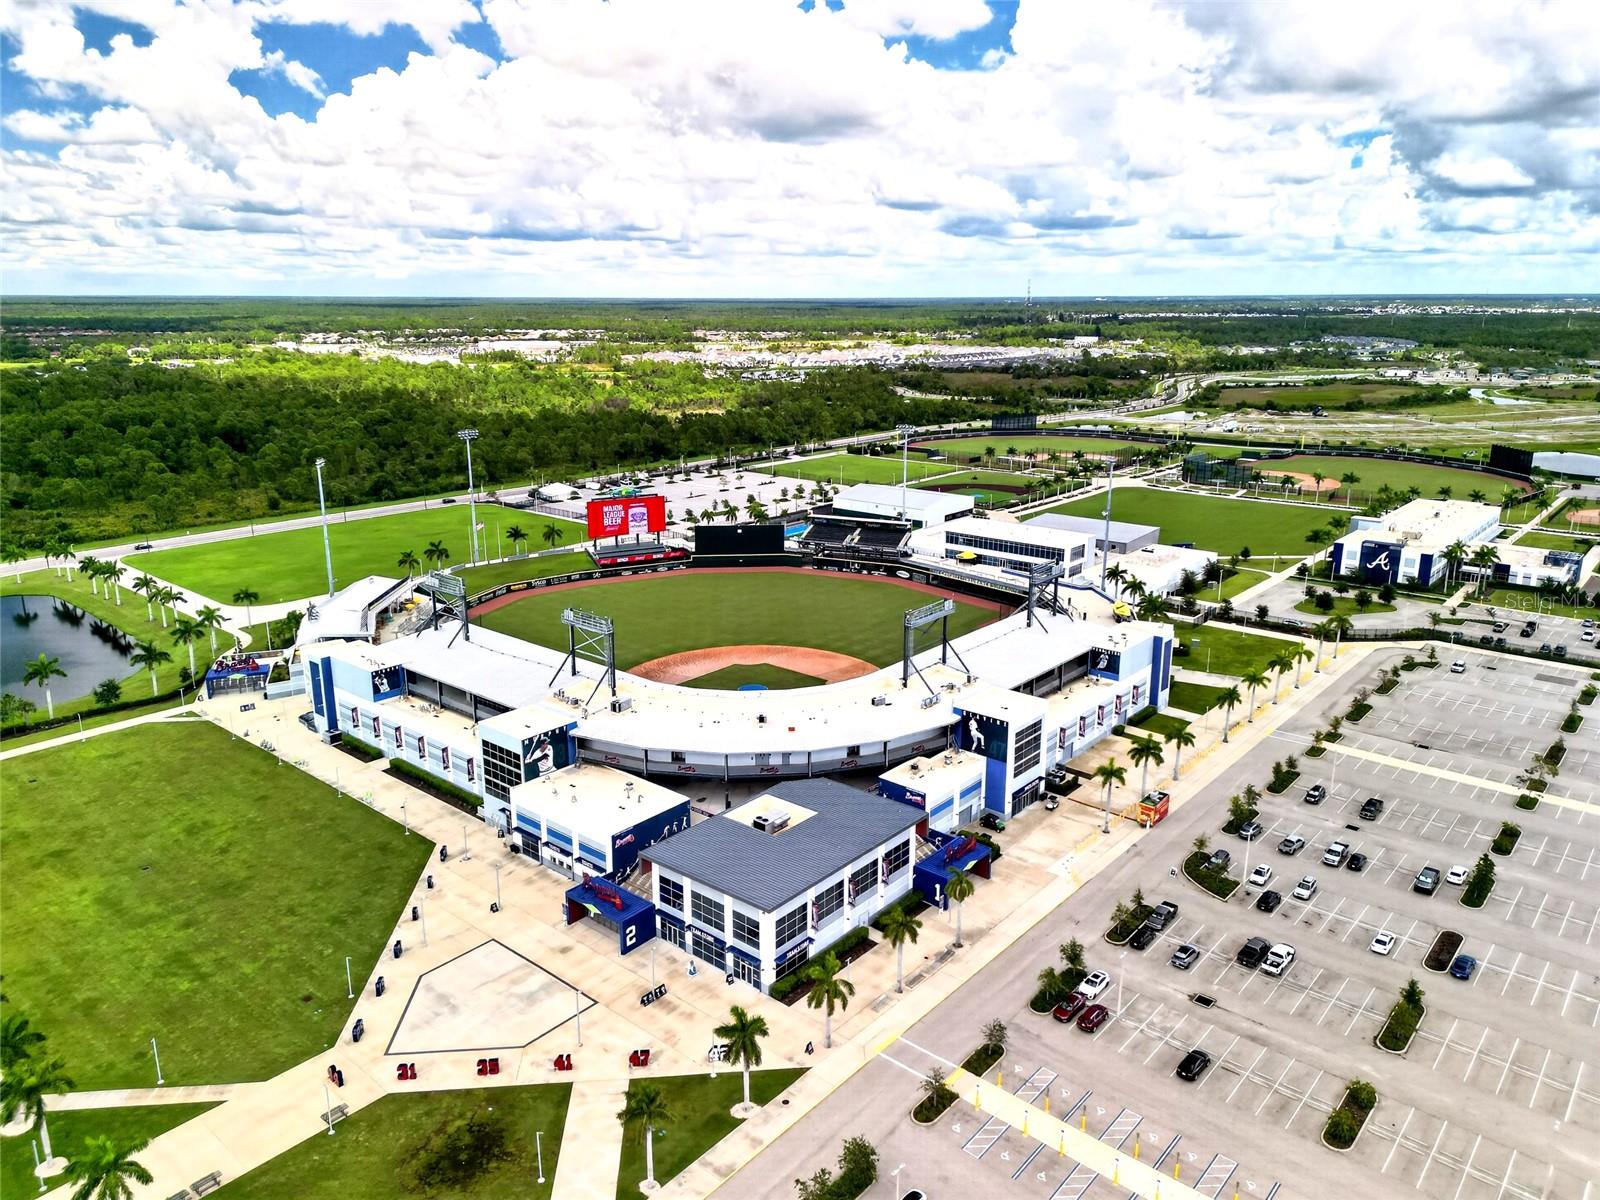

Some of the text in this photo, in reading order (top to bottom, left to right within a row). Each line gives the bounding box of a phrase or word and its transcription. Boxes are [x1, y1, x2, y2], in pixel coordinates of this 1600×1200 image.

[602, 504, 624, 512] MAJOR
[603, 510, 625, 519] LEAGUE
[603, 518, 622, 526] BEER
[934, 884, 940, 901] 1
[626, 925, 636, 947] 2
[690, 926, 702, 937] TEAM
[554, 1054, 573, 1071] 41
[629, 1049, 650, 1067] 47
[397, 1063, 417, 1080] 31
[477, 1058, 499, 1076] 35
